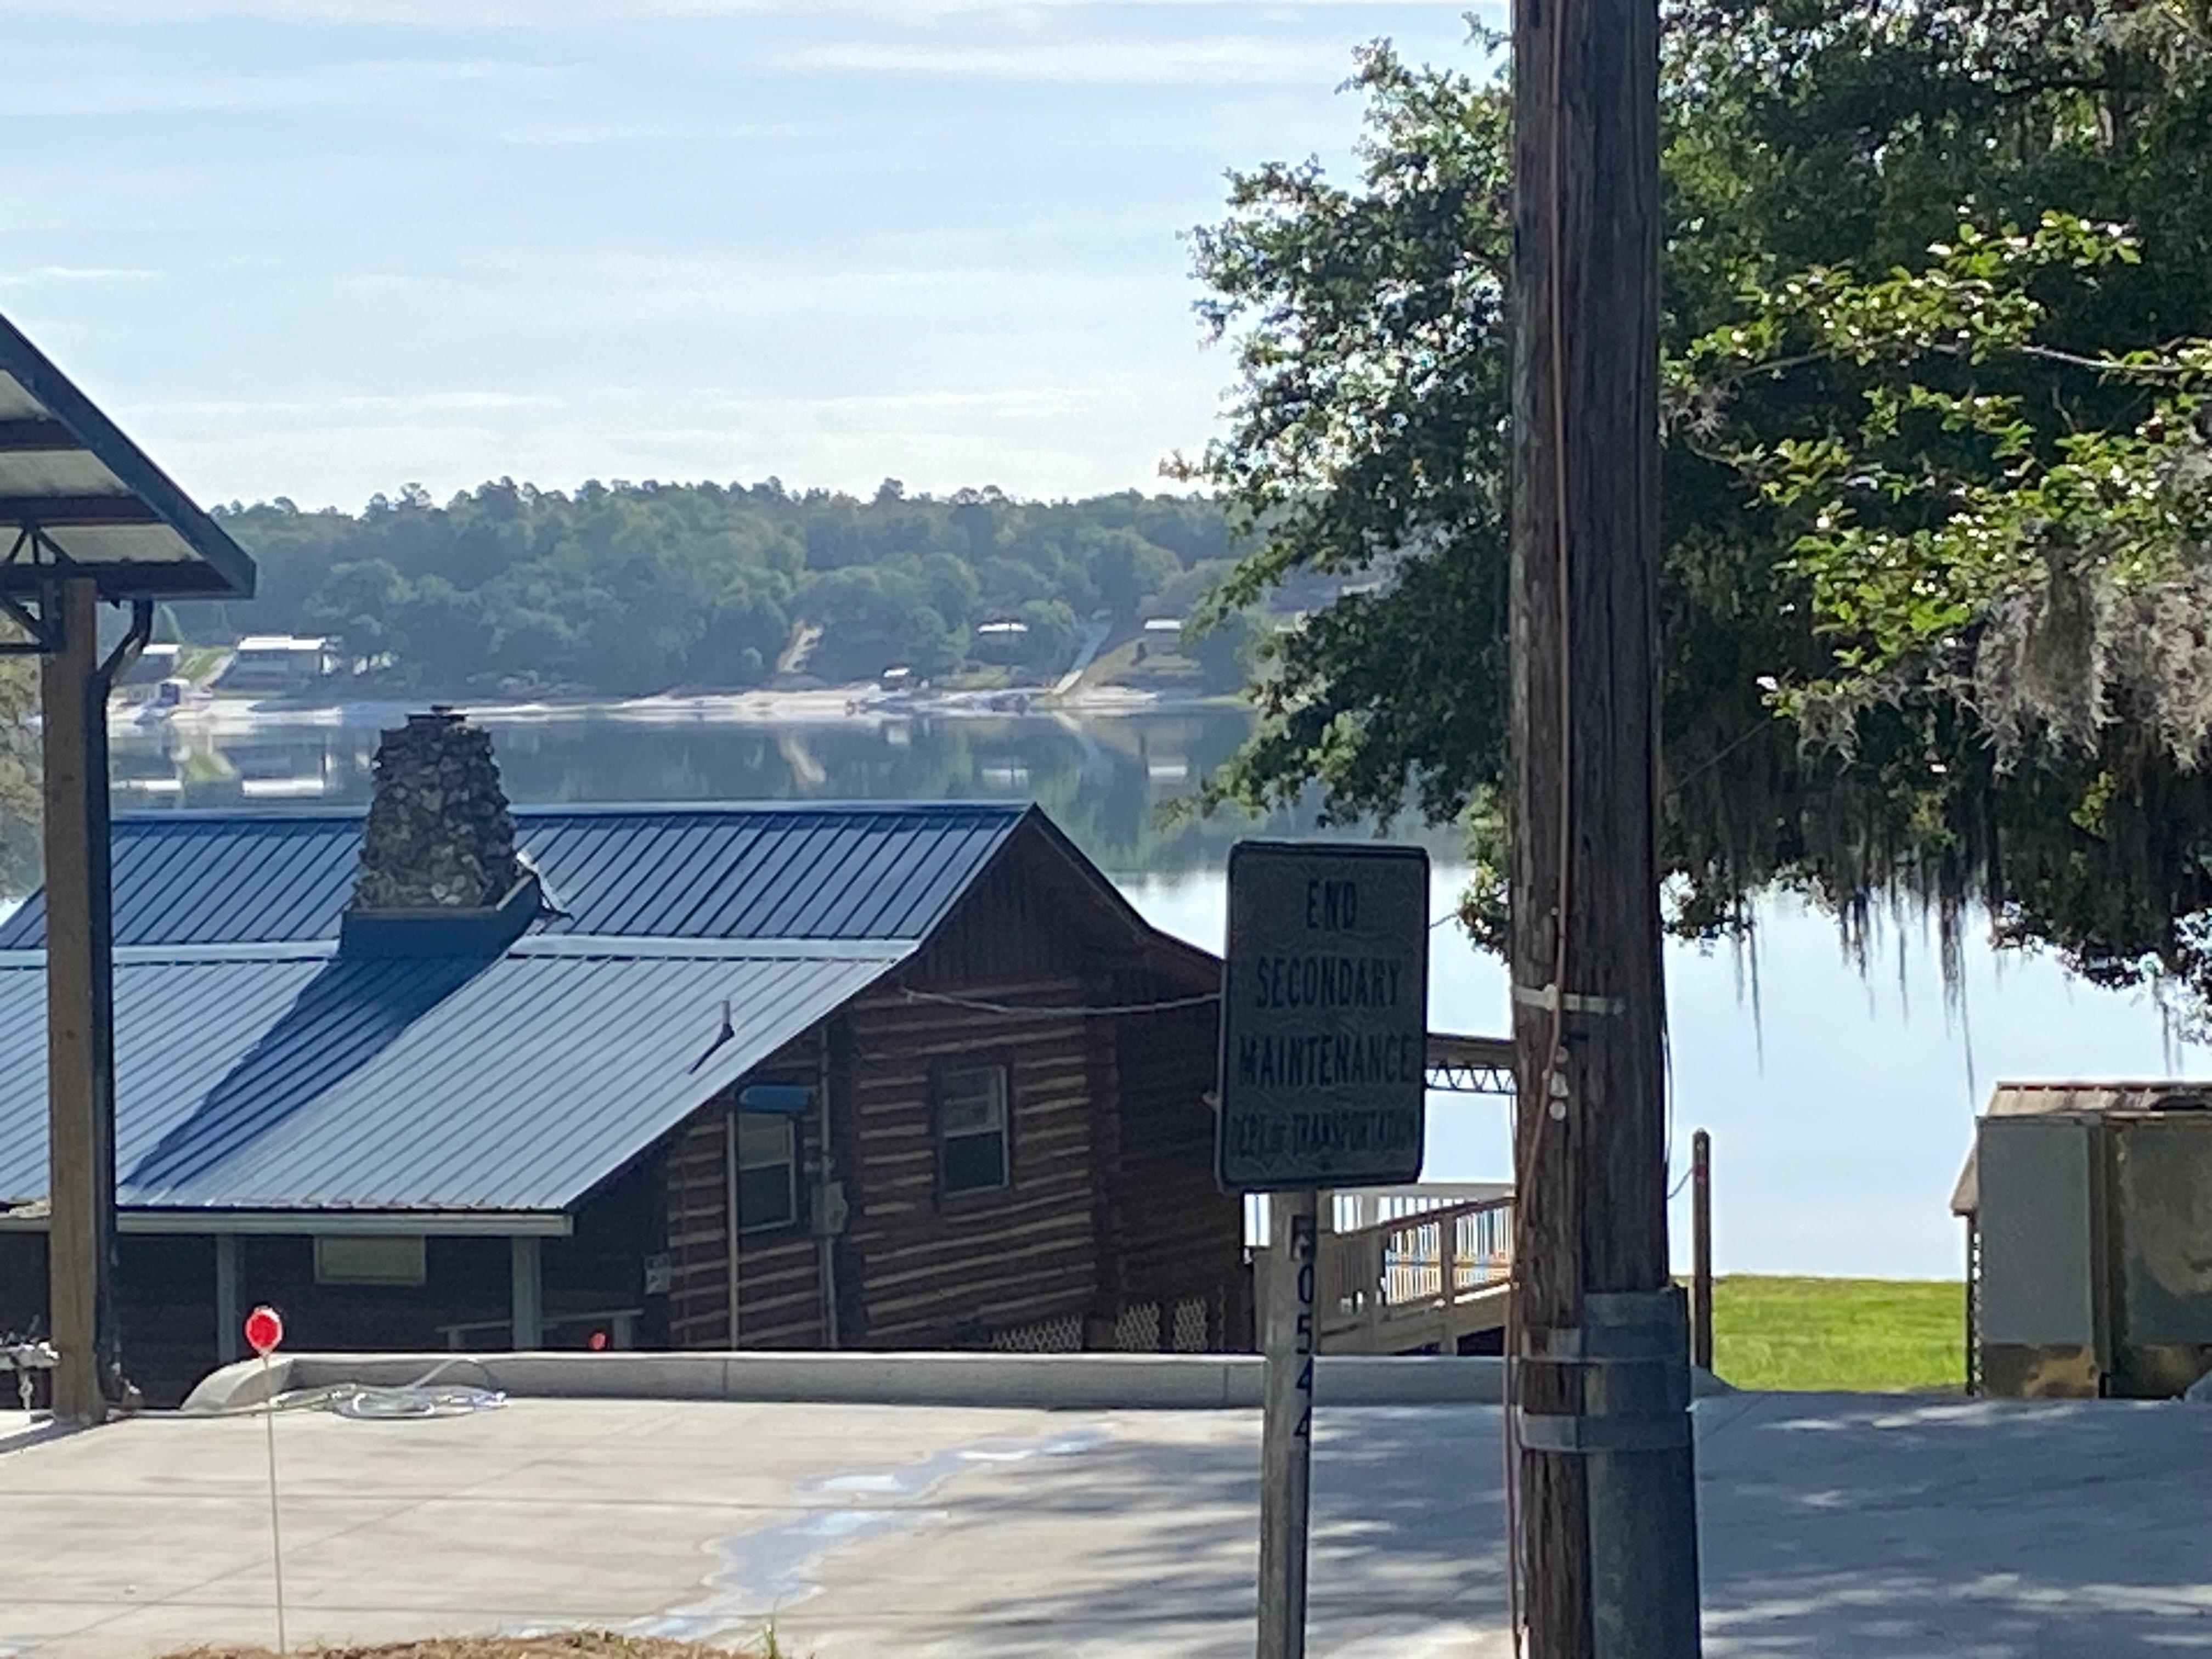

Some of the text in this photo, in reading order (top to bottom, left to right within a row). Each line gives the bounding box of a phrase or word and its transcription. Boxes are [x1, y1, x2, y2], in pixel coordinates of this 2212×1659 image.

[1307, 880, 1357, 932] END
[1256, 956, 1402, 1008] SECONDARY
[1239, 1035, 1417, 1088] MAINTENANCE
